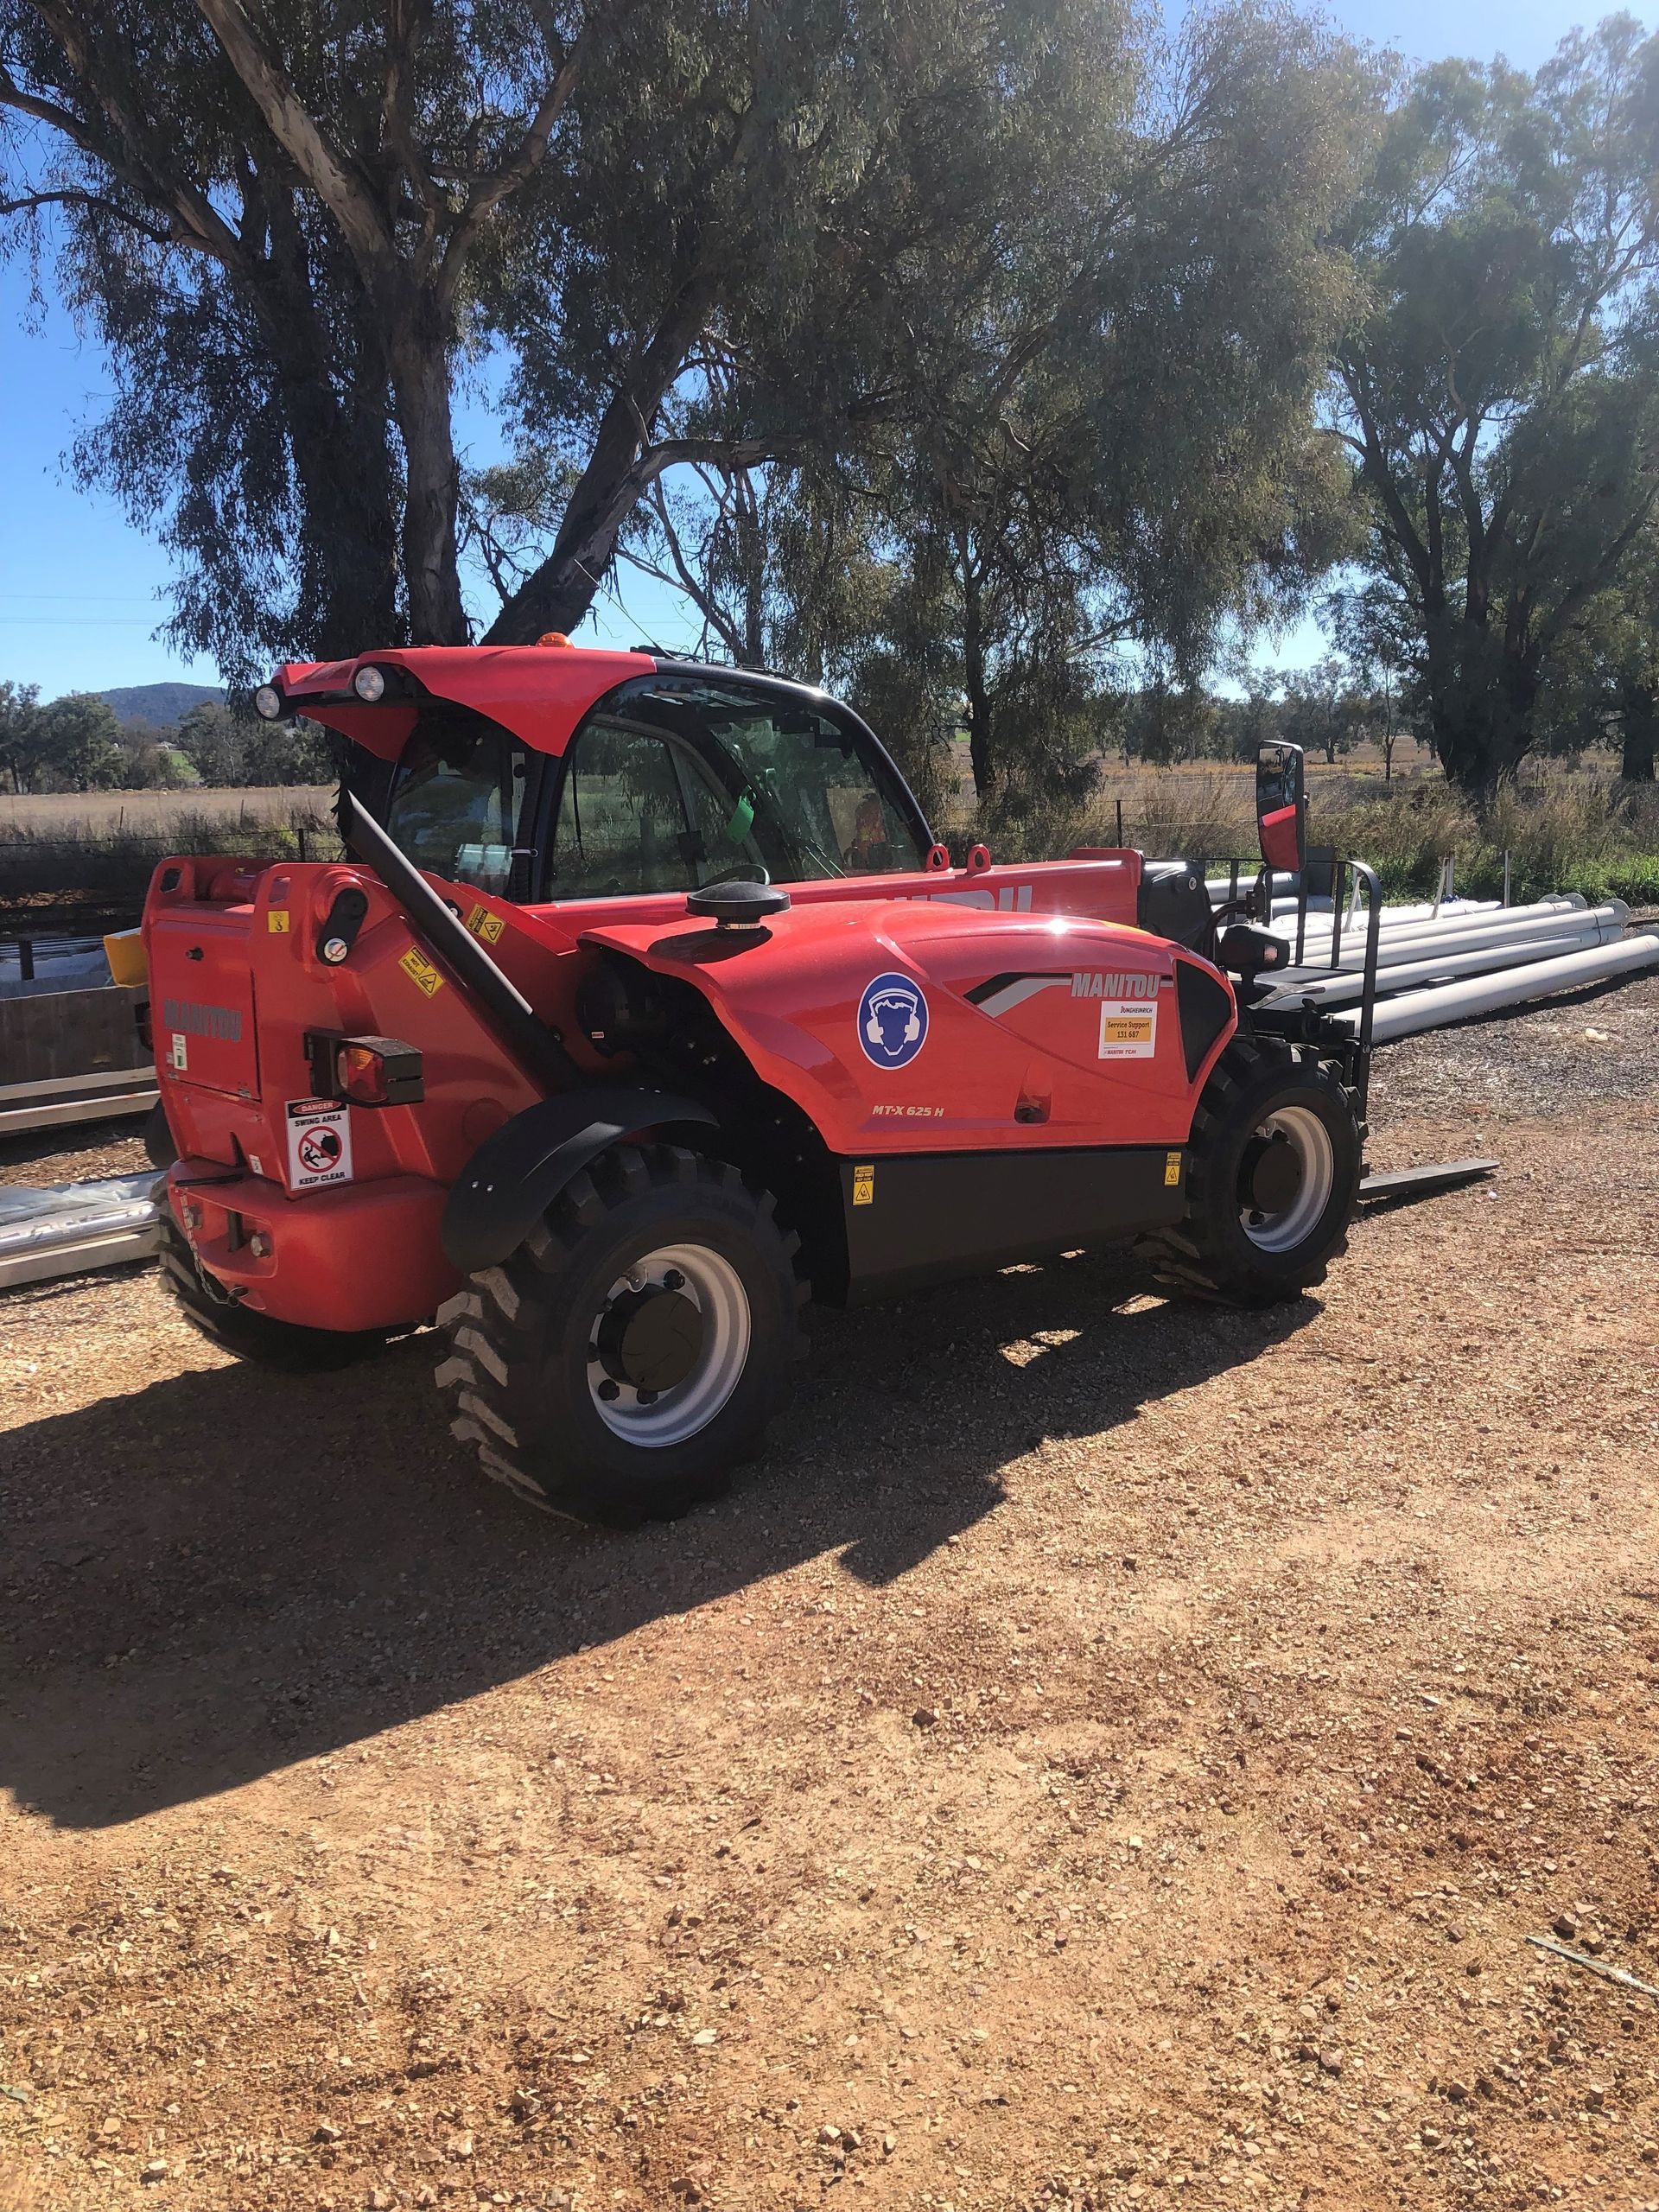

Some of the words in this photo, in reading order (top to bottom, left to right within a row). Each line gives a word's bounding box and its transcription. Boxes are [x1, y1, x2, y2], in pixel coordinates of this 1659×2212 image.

[1071, 973, 1160, 998] MANITOU
[302, 1102, 334, 1112] DANGER
[872, 1105, 905, 1116] MT-X
[906, 1106, 931, 1116] 625
[934, 1107, 944, 1117] H
[295, 1117, 320, 1127] SWING
[321, 1114, 341, 1123] AREA
[299, 1176, 319, 1185] KEEP
[321, 1172, 345, 1181] CLEAR
